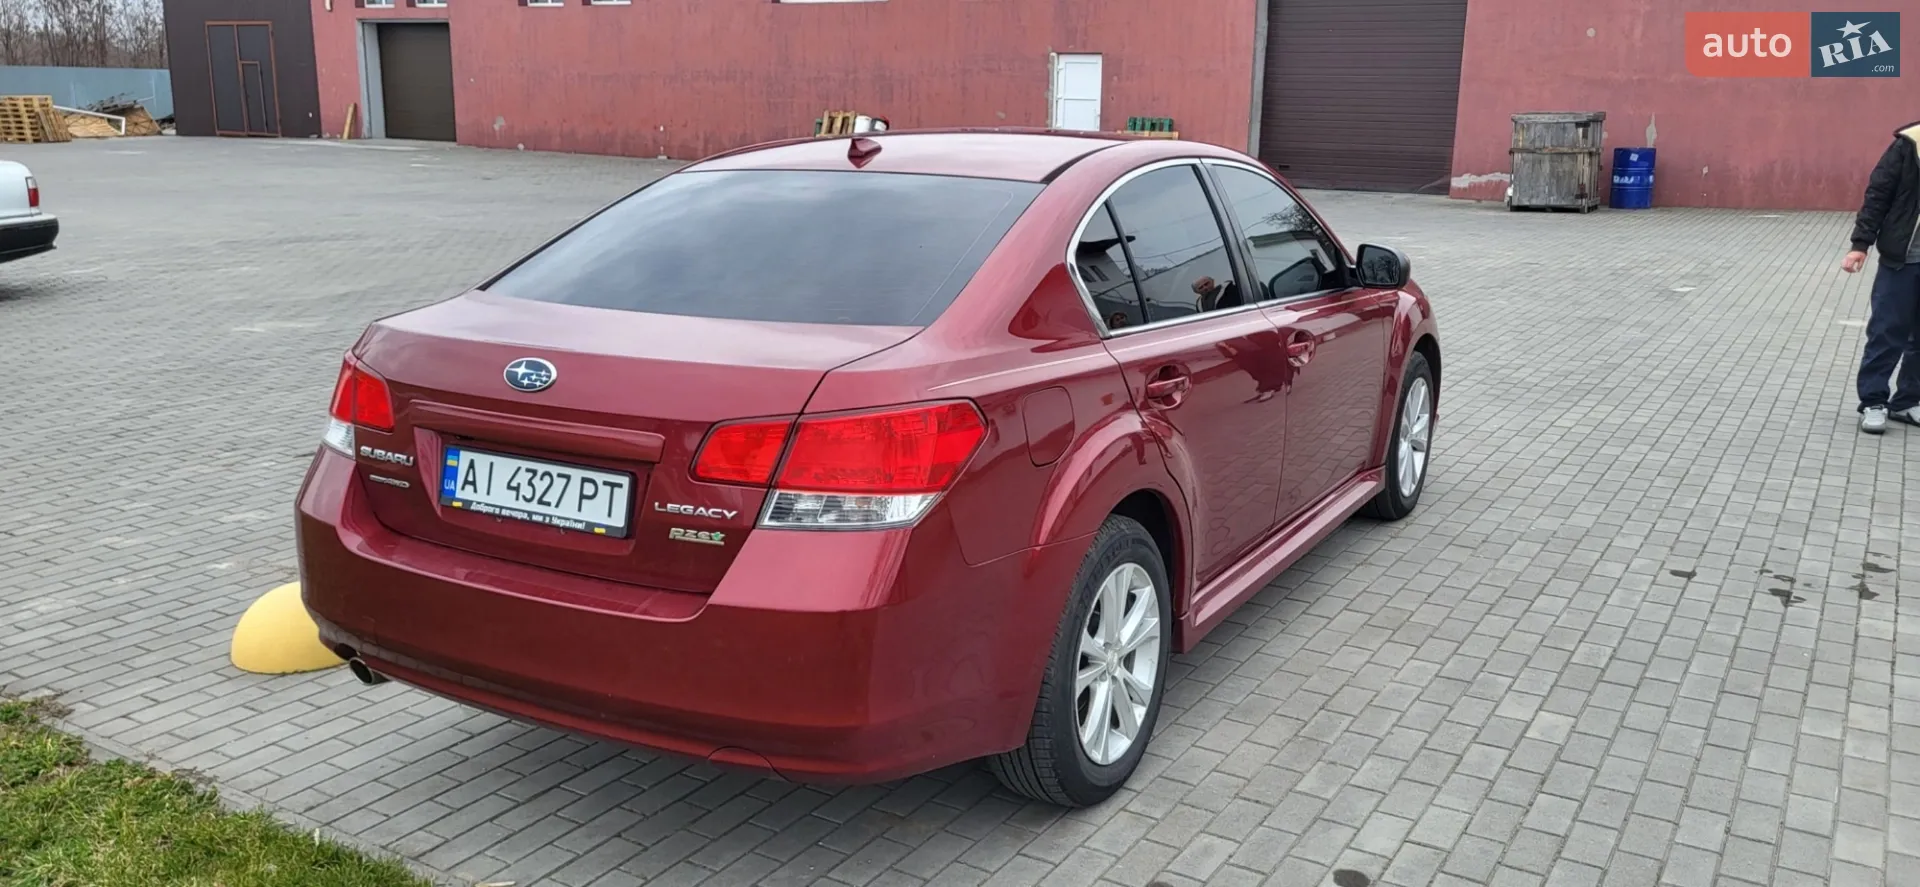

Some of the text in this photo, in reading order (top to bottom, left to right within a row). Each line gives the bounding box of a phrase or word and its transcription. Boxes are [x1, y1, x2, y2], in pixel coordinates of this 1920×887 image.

[360, 445, 414, 467] SUBARU
[444, 478, 456, 491] UA
[460, 458, 624, 518] AI 4327 PT
[470, 501, 500, 514] Доброго
[531, 514, 544, 522] ми
[551, 516, 586, 530] України!
[654, 501, 738, 520] LEGACY
